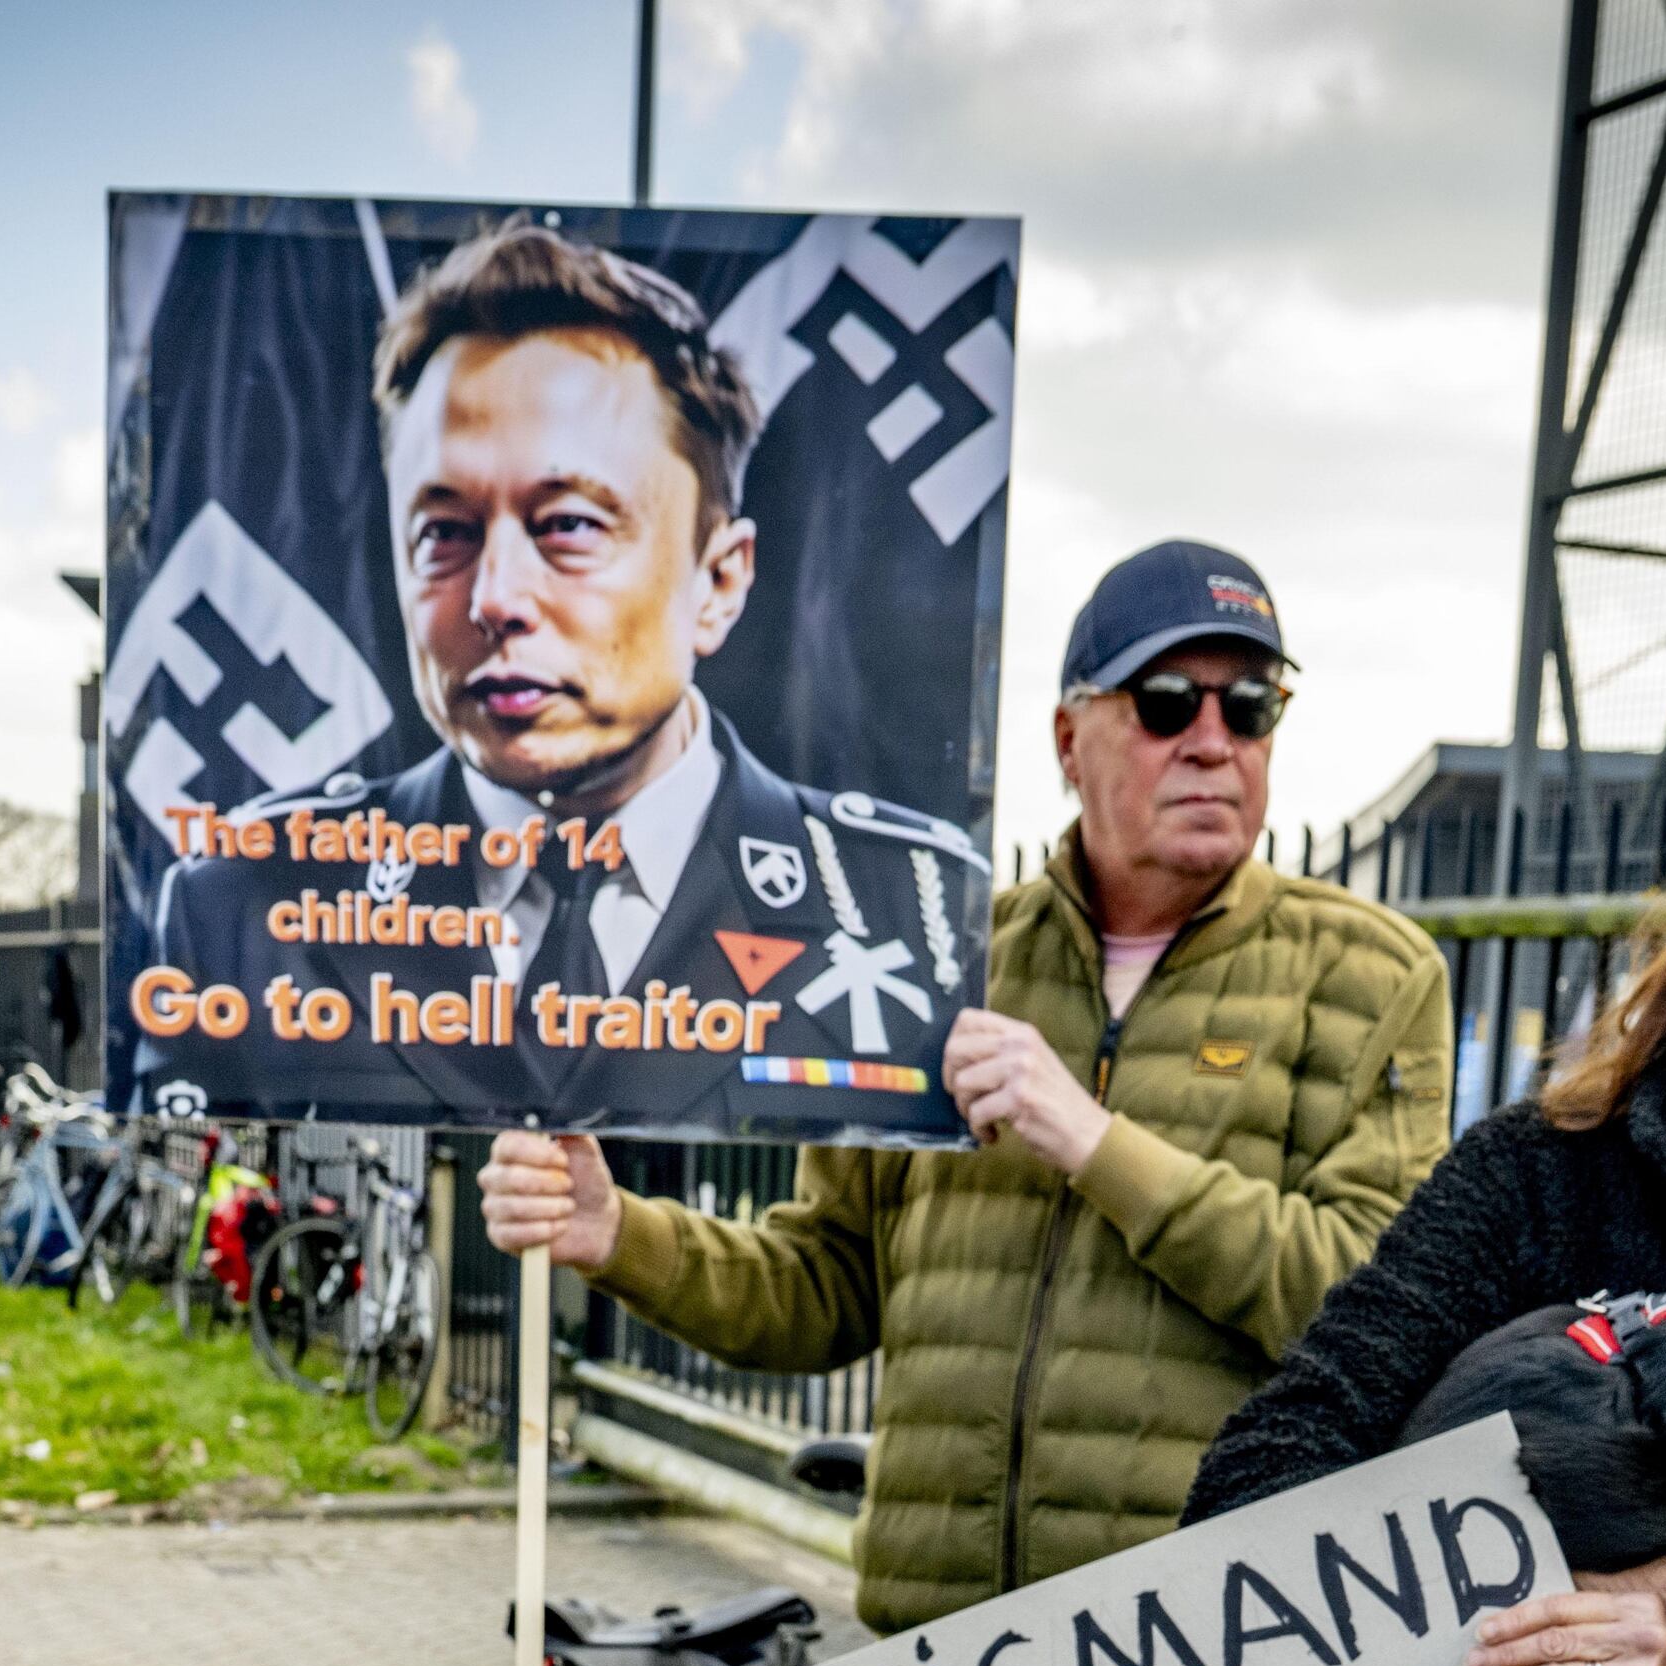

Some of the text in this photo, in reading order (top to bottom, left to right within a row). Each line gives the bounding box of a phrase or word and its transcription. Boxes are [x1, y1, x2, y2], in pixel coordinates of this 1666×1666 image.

[164, 807, 625, 872] The father of 14
[268, 890, 521, 947] children.
[131, 965, 782, 1054] Go to hell traitor
